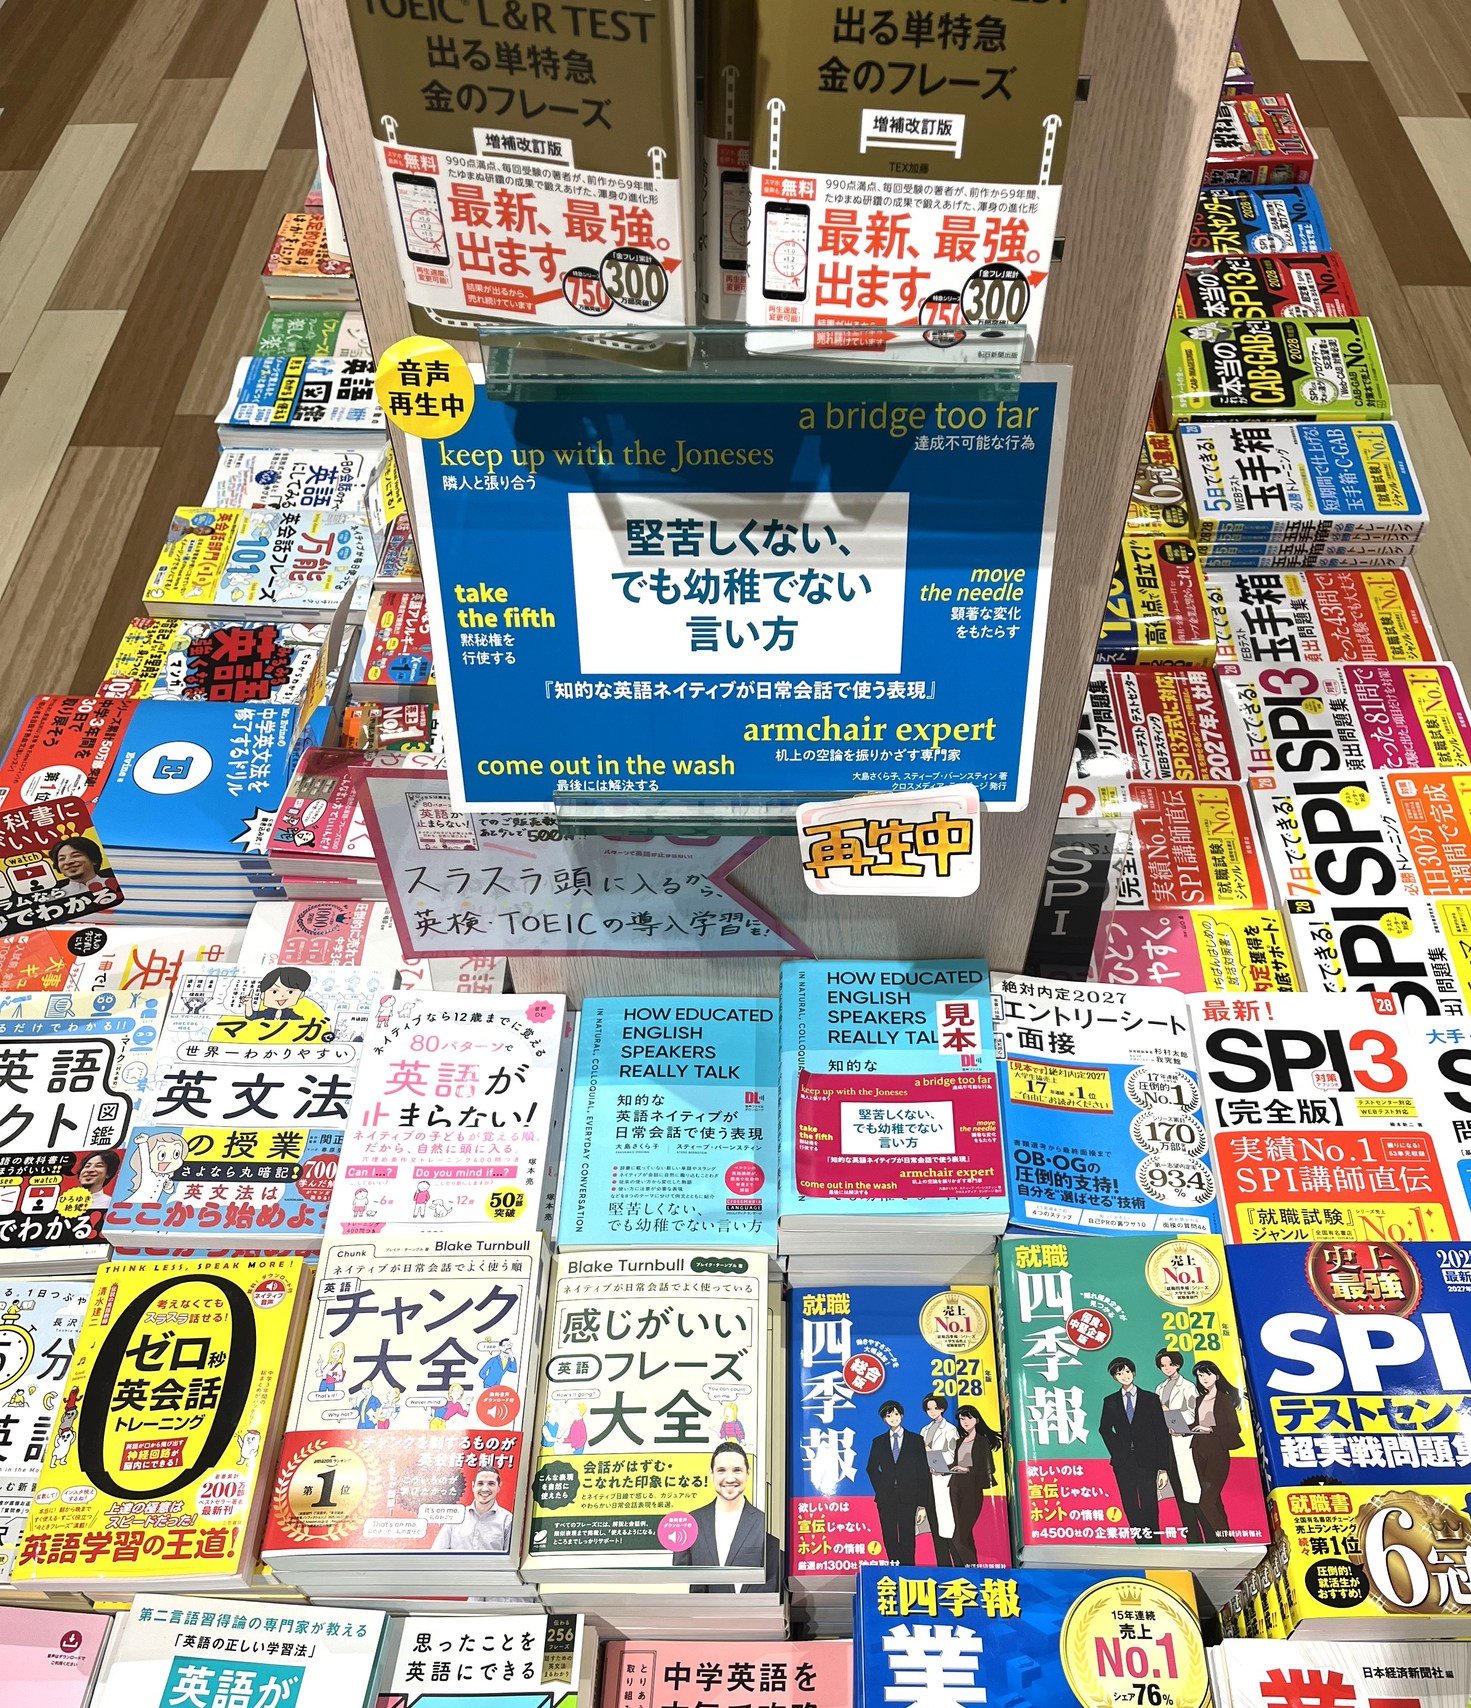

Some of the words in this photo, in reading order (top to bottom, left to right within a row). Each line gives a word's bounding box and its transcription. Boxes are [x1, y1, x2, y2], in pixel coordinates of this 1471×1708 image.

[833, 5, 1006, 52] 出る単特急
[426, 35, 597, 84] 出る単特急
[818, 56, 1017, 100] 金のフレーズ
[421, 80, 612, 129] 金のフレーズ
[873, 116, 952, 136] 増補改訂版
[485, 133, 562, 157] 増補改訂版
[403, 152, 438, 172] 無料
[448, 183, 670, 252] 最新、最強。
[818, 209, 1040, 264] 最新、最強。
[966, 278, 1026, 322] 300
[1290, 337, 1302, 361] 2028
[398, 359, 450, 387] 音声
[1213, 342, 1246, 396] 本当の
[389, 391, 464, 418] 再生中
[799, 407, 815, 430] a
[827, 402, 924, 437] bridge
[935, 403, 987, 430] too
[996, 401, 1039, 429] far
[914, 435, 1036, 451] 達成不可能な行為
[440, 441, 503, 474] keep
[512, 450, 545, 474] up
[553, 440, 613, 466] with
[622, 440, 666, 465] the
[671, 440, 775, 473] Joneses
[1199, 438, 1232, 511] 5日でできる!
[1230, 427, 1288, 511] 玉手箱
[301, 465, 338, 508] 英語
[442, 475, 536, 491] 隣人と張り合う
[626, 518, 851, 558] 堅苦しくない、
[227, 536, 269, 575] 101
[258, 512, 301, 604] 英会話フレーズ
[289, 531, 336, 583] 万能
[970, 566, 1025, 583] move
[455, 582, 508, 603] take
[611, 567, 872, 605] でも幼稚でない
[920, 583, 951, 602] the
[956, 582, 1024, 602] needle
[458, 608, 497, 628] the
[504, 607, 555, 628] fifth
[951, 607, 1021, 621] 顕著な変化
[1235, 574, 1301, 662] 玉手箱
[461, 633, 515, 647] 黙秘権を
[686, 615, 798, 652] 言い方
[956, 624, 1020, 639] をもたらす
[462, 651, 516, 665] 行使する
[544, 680, 936, 700] 『知的な英語ネイティブが日常会話で使う表現』
[1258, 667, 1341, 773] SPI3
[743, 716, 886, 742] armchair
[896, 717, 996, 749] expert
[227, 708, 255, 797] 修了するドリル
[247, 707, 278, 795] 中学英文法を
[775, 749, 961, 762] 机上の空論を振りかざす専門家
[477, 758, 543, 776] come
[550, 757, 591, 776] out
[598, 755, 619, 775] in
[626, 755, 667, 776] the
[672, 755, 735, 776] wash
[803, 812, 973, 878] 再生中
[1161, 790, 1204, 903] SPI講師直伝
[1272, 795, 1322, 896] 7日でできる!
[1293, 781, 1396, 896] SPI
[827, 972, 875, 985] HOW
[881, 970, 982, 986] EDUCATED
[828, 991, 911, 1004] ENGLISH
[1001, 979, 1127, 1005] 絶対内定2027
[623, 1008, 671, 1021] HOW
[675, 1008, 773, 1022] EDUCATED
[828, 1011, 927, 1024] SPEAKERS
[1004, 1000, 1186, 1035] エントリーシート
[1202, 999, 1274, 1022] 最新!
[622, 1027, 702, 1039] ENGLISH
[828, 1030, 898, 1044] REALLY
[905, 1031, 940, 1044] TAL
[942, 1003, 977, 1052] 見本
[186, 1046, 349, 1059] 世界一わかりやすい
[620, 1045, 716, 1059] SPEAKERS
[1205, 1027, 1408, 1093] SPI3
[619, 1064, 689, 1078] REALLY
[694, 1065, 740, 1079] TALK
[829, 1060, 878, 1072] 知的な
[384, 1060, 530, 1098] 英語が
[152, 1070, 353, 1120] 英文法
[617, 1094, 664, 1106] 知的な
[616, 1110, 738, 1123] 英語ネイティブが
[859, 1108, 936, 1120] 堅苦しくない、
[1215, 1098, 1344, 1127] 【完全版】
[616, 1127, 763, 1140] 日常会話で使う表現
[853, 1123, 942, 1134] でも幼稚でない
[188, 1131, 302, 1160] の授業
[879, 1137, 918, 1149] 言い方
[900, 1167, 952, 1177] armchair
[957, 1167, 994, 1178] expert
[1236, 1165, 1433, 1193] SPI講師直伝
[184, 1184, 278, 1200] 英文法は
[609, 1202, 702, 1217] 堅苦しくない、
[1247, 1208, 1354, 1226] 『就職試験』
[608, 1218, 762, 1234] でも幼稚でない言い方
[1252, 1228, 1309, 1241] ジャンル
[337, 1249, 367, 1259] Chunk
[435, 1241, 472, 1251] Blake
[477, 1240, 531, 1251] Turnbull
[568, 1260, 613, 1274] Blake
[619, 1258, 684, 1272] Turnbull
[1015, 1244, 1069, 1269] 就職
[1170, 1255, 1196, 1266] 売上
[1162, 1267, 1204, 1285] No.1
[324, 1281, 352, 1294] 英語
[563, 1282, 753, 1294] ネイティブが日常会話でよく使っている
[1329, 1274, 1406, 1302] 最強
[157, 1298, 224, 1309] 考えなくても
[326, 1285, 519, 1337] チャンク
[802, 1293, 851, 1316] 就職
[943, 1305, 966, 1316] 売上
[144, 1312, 228, 1324] スラスラ話せる!
[561, 1305, 747, 1344] 感じがいい
[935, 1316, 973, 1333] No.1
[1162, 1312, 1216, 1331] 2027
[126, 1331, 227, 1372] ゼロ秒
[1166, 1333, 1221, 1352] 2028
[1261, 1312, 1471, 1395] SPI
[348, 1337, 479, 1396] 大全
[604, 1348, 749, 1382] フレーズ
[931, 1359, 980, 1377] 2027
[110, 1376, 222, 1413] 英会話
[932, 1378, 983, 1397] 2028
[114, 1414, 205, 1433] トレーニング
[588, 1389, 713, 1447] 大全
[1027, 1465, 1083, 1477] 欲しいのは
[582, 1476, 708, 1490] こなれた印象になる!
[201, 1505, 235, 1516] 最新刊
[798, 1502, 850, 1513] 欲しいのは
[1287, 1493, 1352, 1513] 就職書
[798, 1520, 872, 1533] 宣伝じゃない、
[1032, 1527, 1189, 1540] 約4500社の企業研究を一冊で
[1215, 1530, 1263, 1538] 東洋経済新報社
[1295, 1523, 1357, 1534] 売上ランキング
[18, 1527, 239, 1565] 英語学習の王道!
[1311, 1534, 1362, 1556] 第1位
[1317, 1566, 1353, 1578] 圧倒的!
[1318, 1577, 1360, 1589] 就活生が
[898, 1577, 1022, 1620] 四季報
[1318, 1589, 1363, 1600] おすすめ!
[138, 1606, 368, 1638] 第二言語習得論の専門家が教える
[1111, 1610, 1156, 1623] 15年連続
[546, 1627, 574, 1642] 256
[1119, 1623, 1152, 1641] 売上
[411, 1632, 537, 1654] 思ったことを
[1094, 1634, 1180, 1680] No.1
[405, 1660, 536, 1683] 英語にできる
[664, 1661, 818, 1692] 中学英語を
